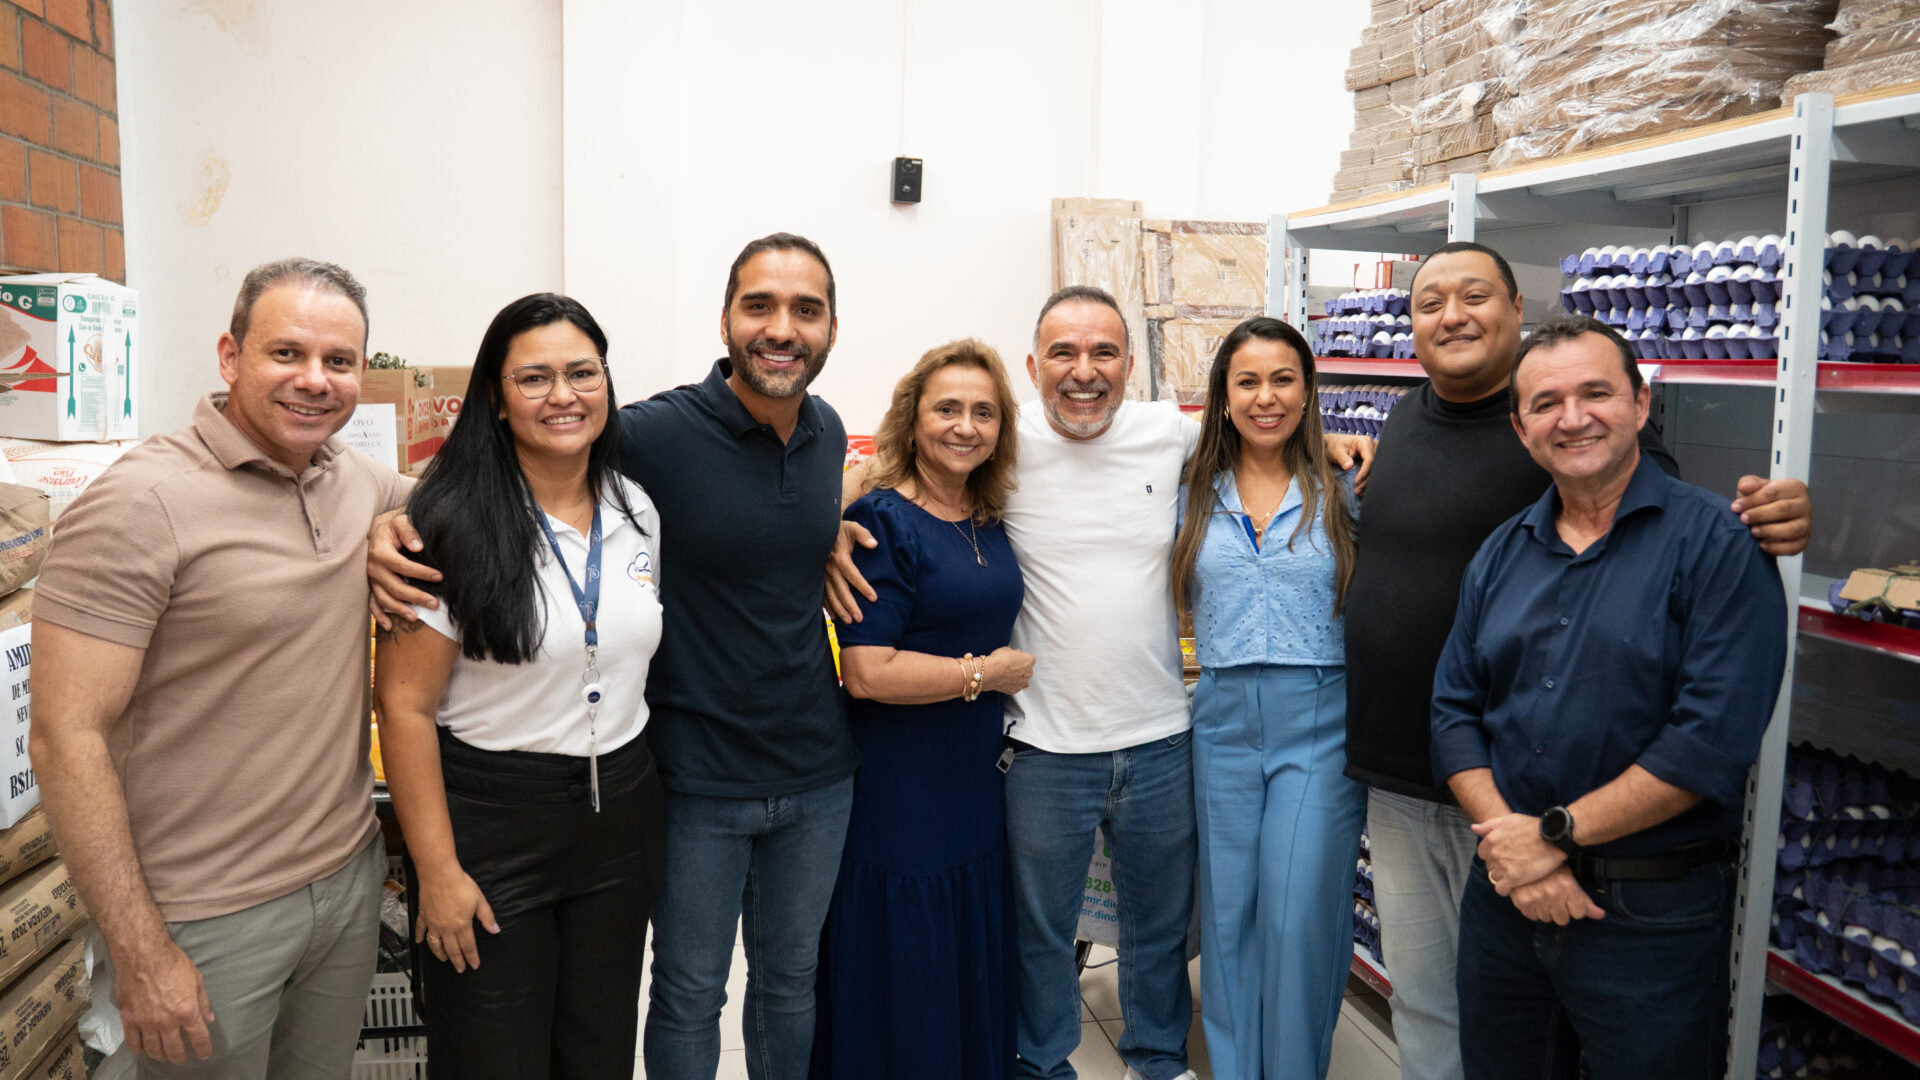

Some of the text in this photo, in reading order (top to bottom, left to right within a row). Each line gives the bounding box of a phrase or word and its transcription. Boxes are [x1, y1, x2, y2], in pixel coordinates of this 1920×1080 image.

[18, 295, 33, 310] G
[11, 682, 21, 701] DE
[16, 703, 31, 725] NEV
[15, 734, 25, 757] SC
[9, 767, 38, 800] R$11
